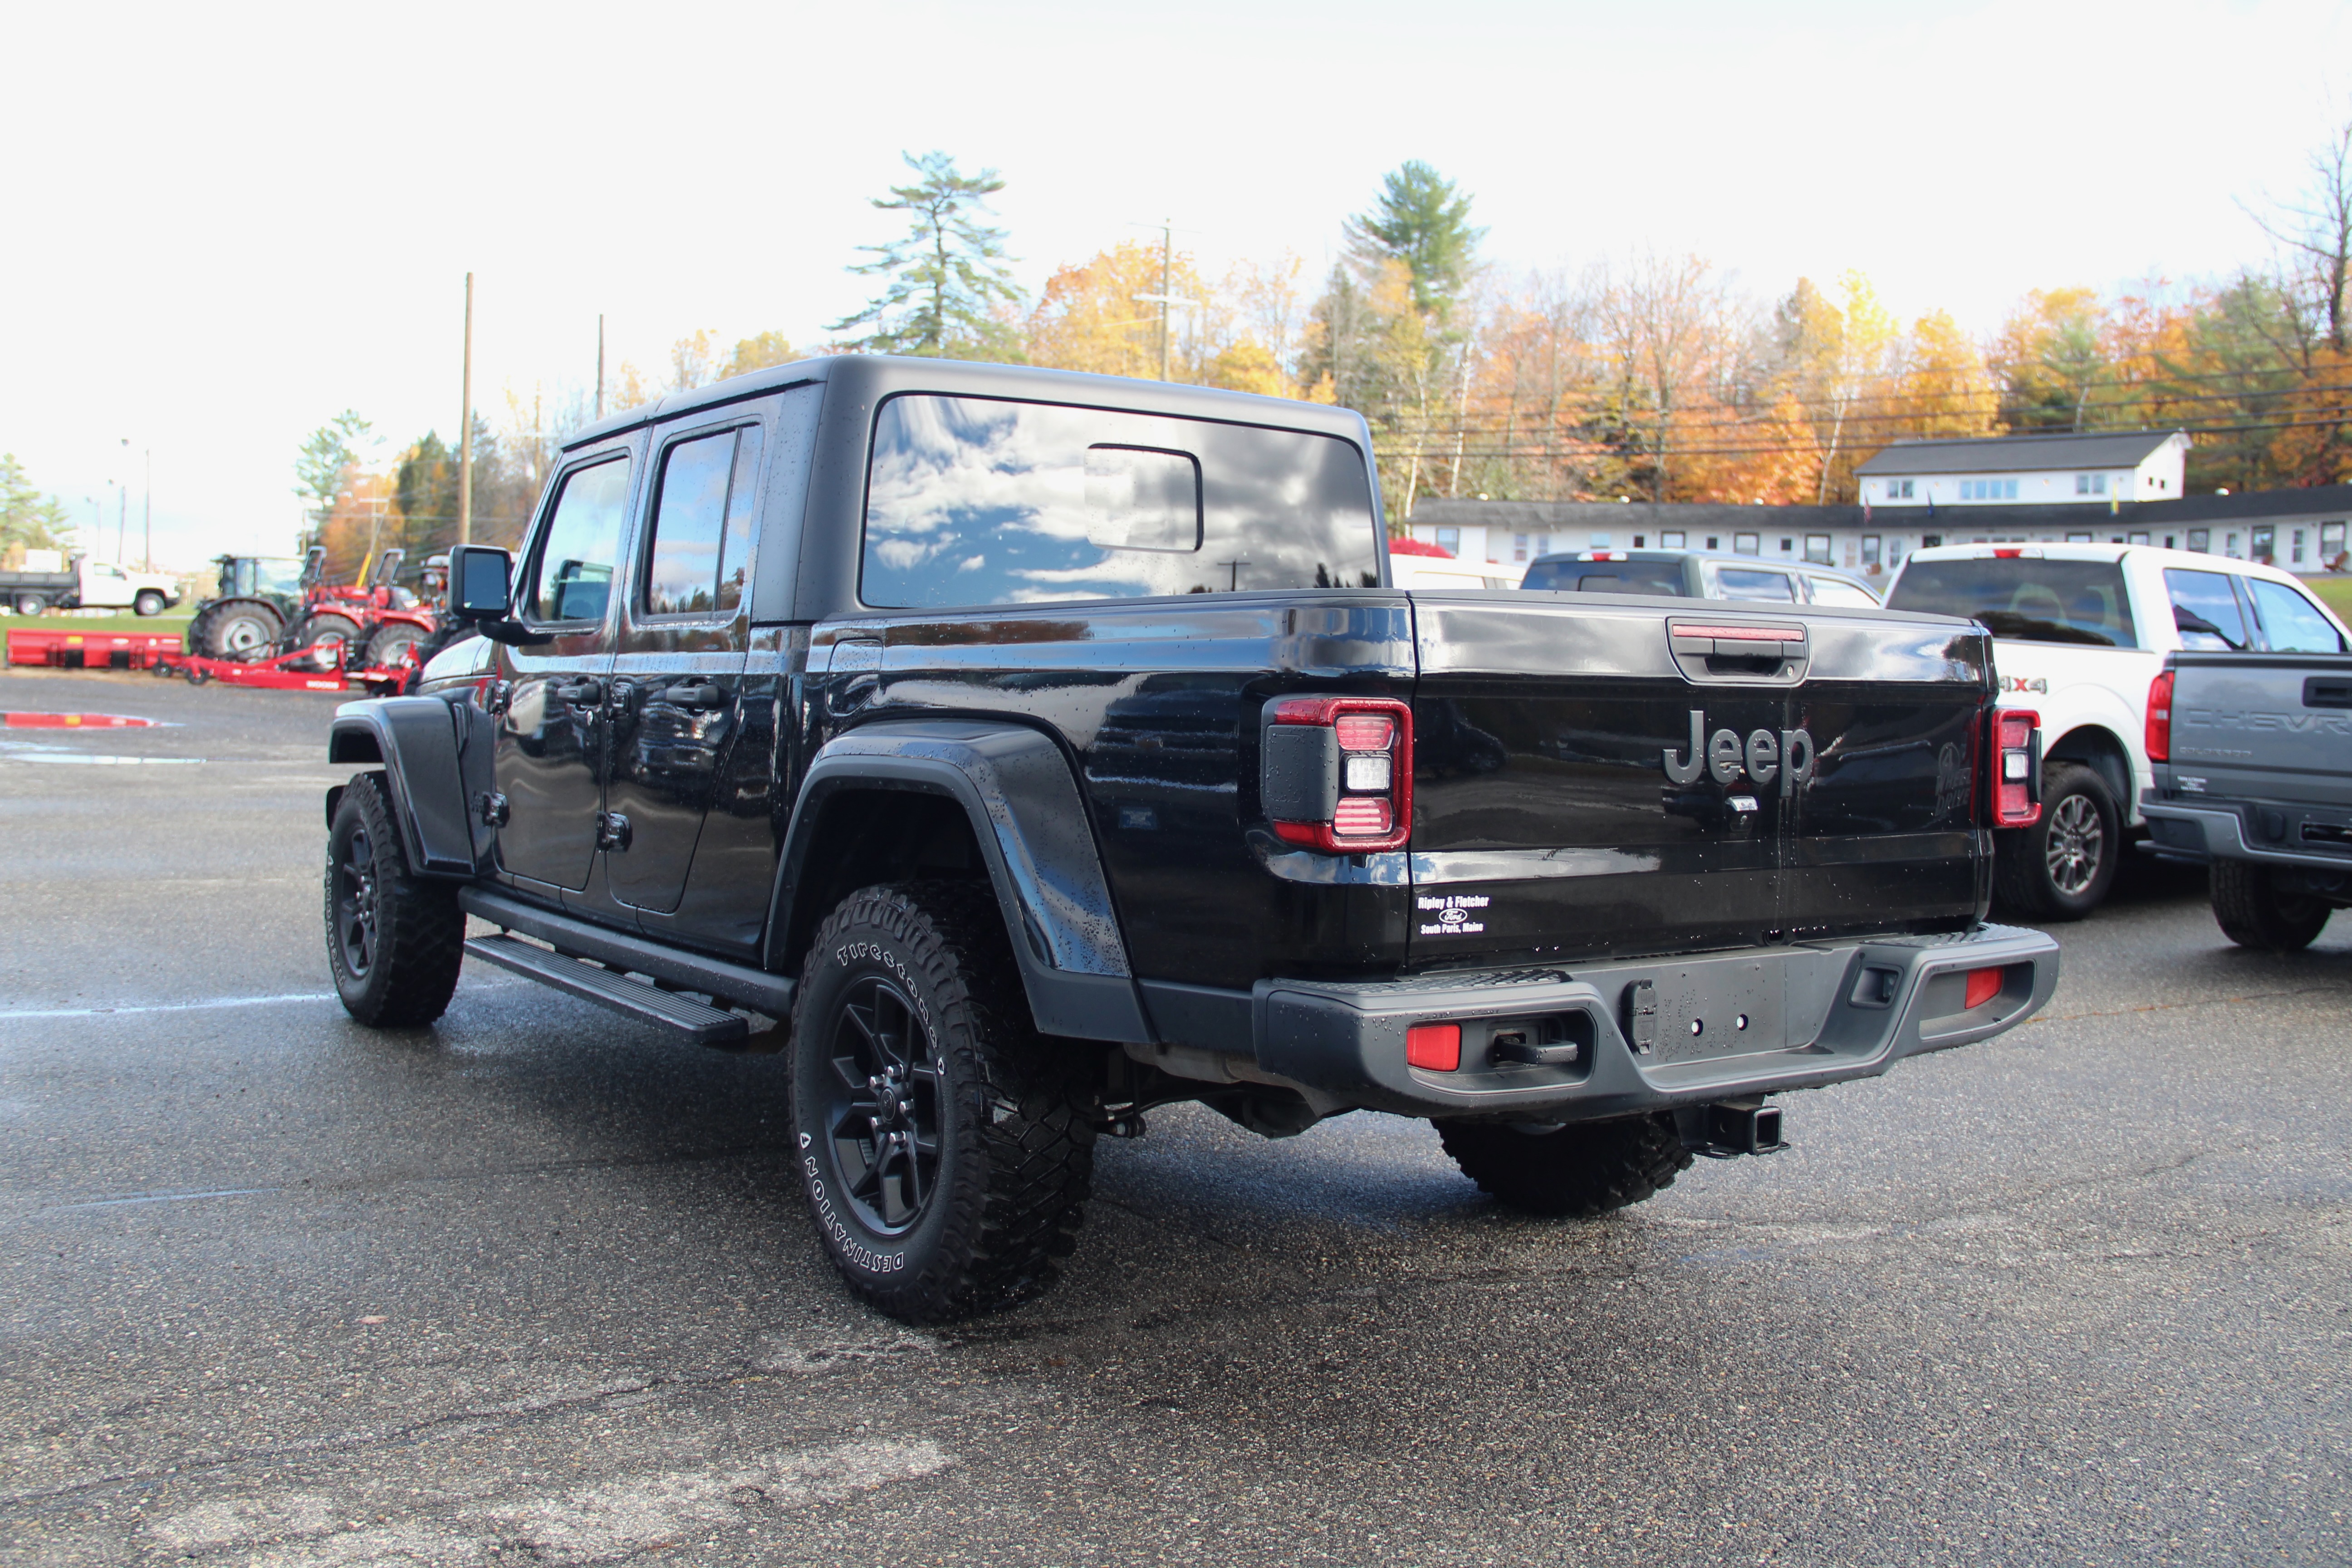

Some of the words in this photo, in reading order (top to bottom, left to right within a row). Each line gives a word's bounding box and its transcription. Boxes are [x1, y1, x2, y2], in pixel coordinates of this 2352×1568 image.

[1661, 710, 1814, 797] Jeep
[2179, 746, 2252, 757] COLORADO
[1418, 897, 1445, 911] Ripley
[1446, 896, 1454, 908] &
[1455, 895, 1490, 908] Fletcher
[1444, 910, 1463, 921] Ford
[1421, 924, 1441, 935] South
[1442, 923, 1461, 934] Paris,
[1462, 922, 1484, 933] Maine
[837, 942, 937, 1049] Firestone
[805, 1156, 904, 1272] DESTINATION
